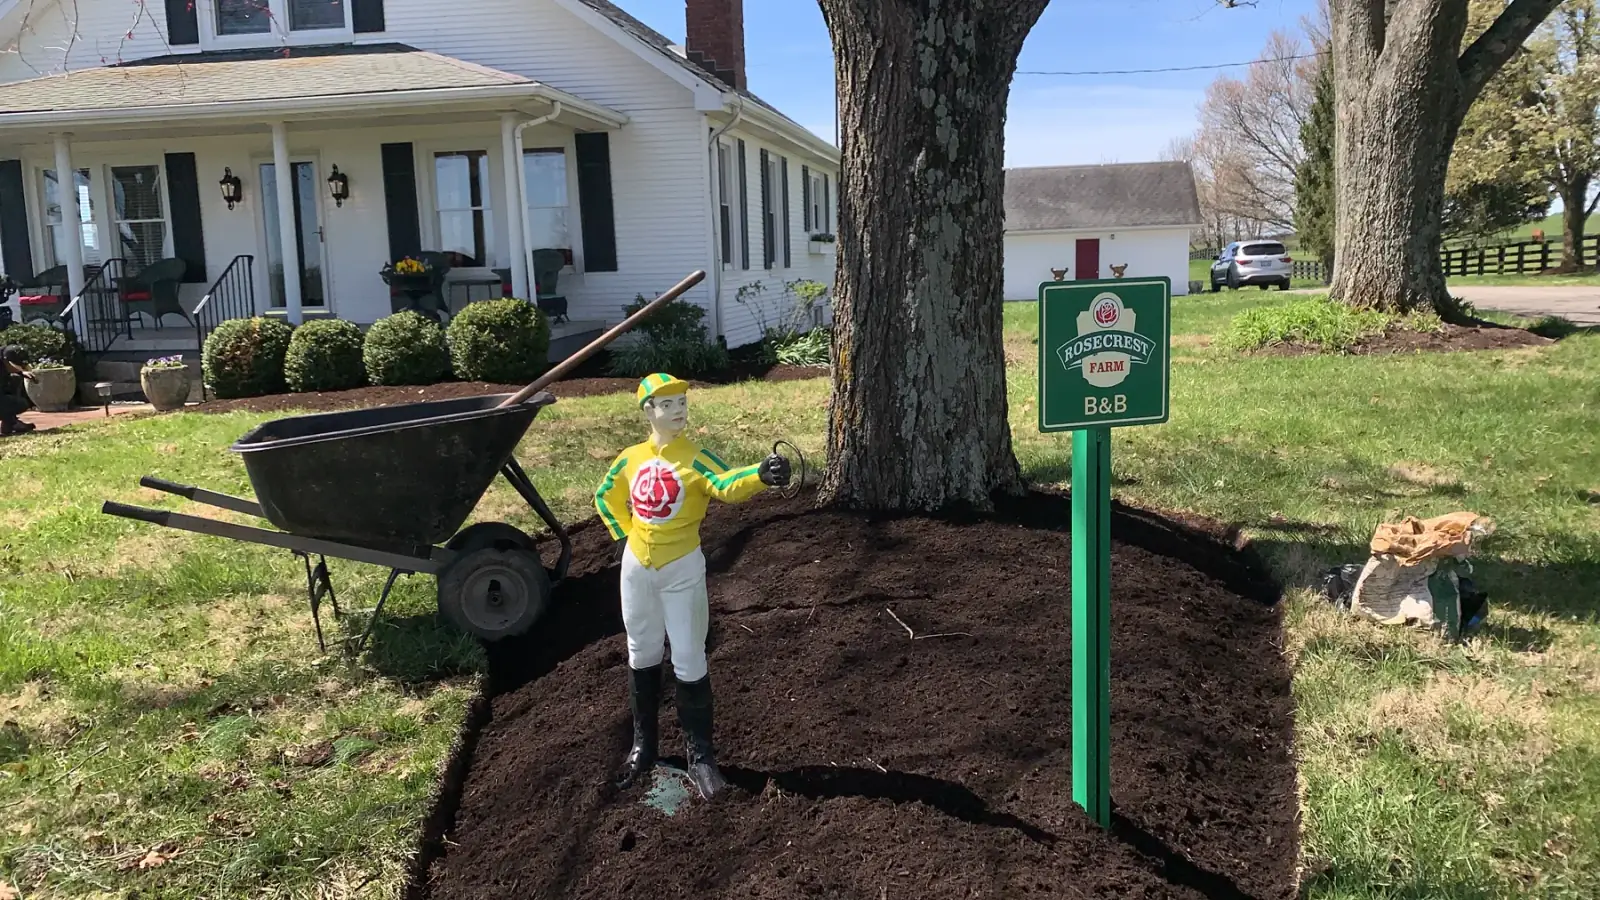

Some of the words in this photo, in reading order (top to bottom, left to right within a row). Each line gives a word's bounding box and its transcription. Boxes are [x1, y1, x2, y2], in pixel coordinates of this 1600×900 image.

[1064, 334, 1149, 363] ROSECREST
[1089, 360, 1125, 373] FARM
[1084, 394, 1127, 415] B&B
